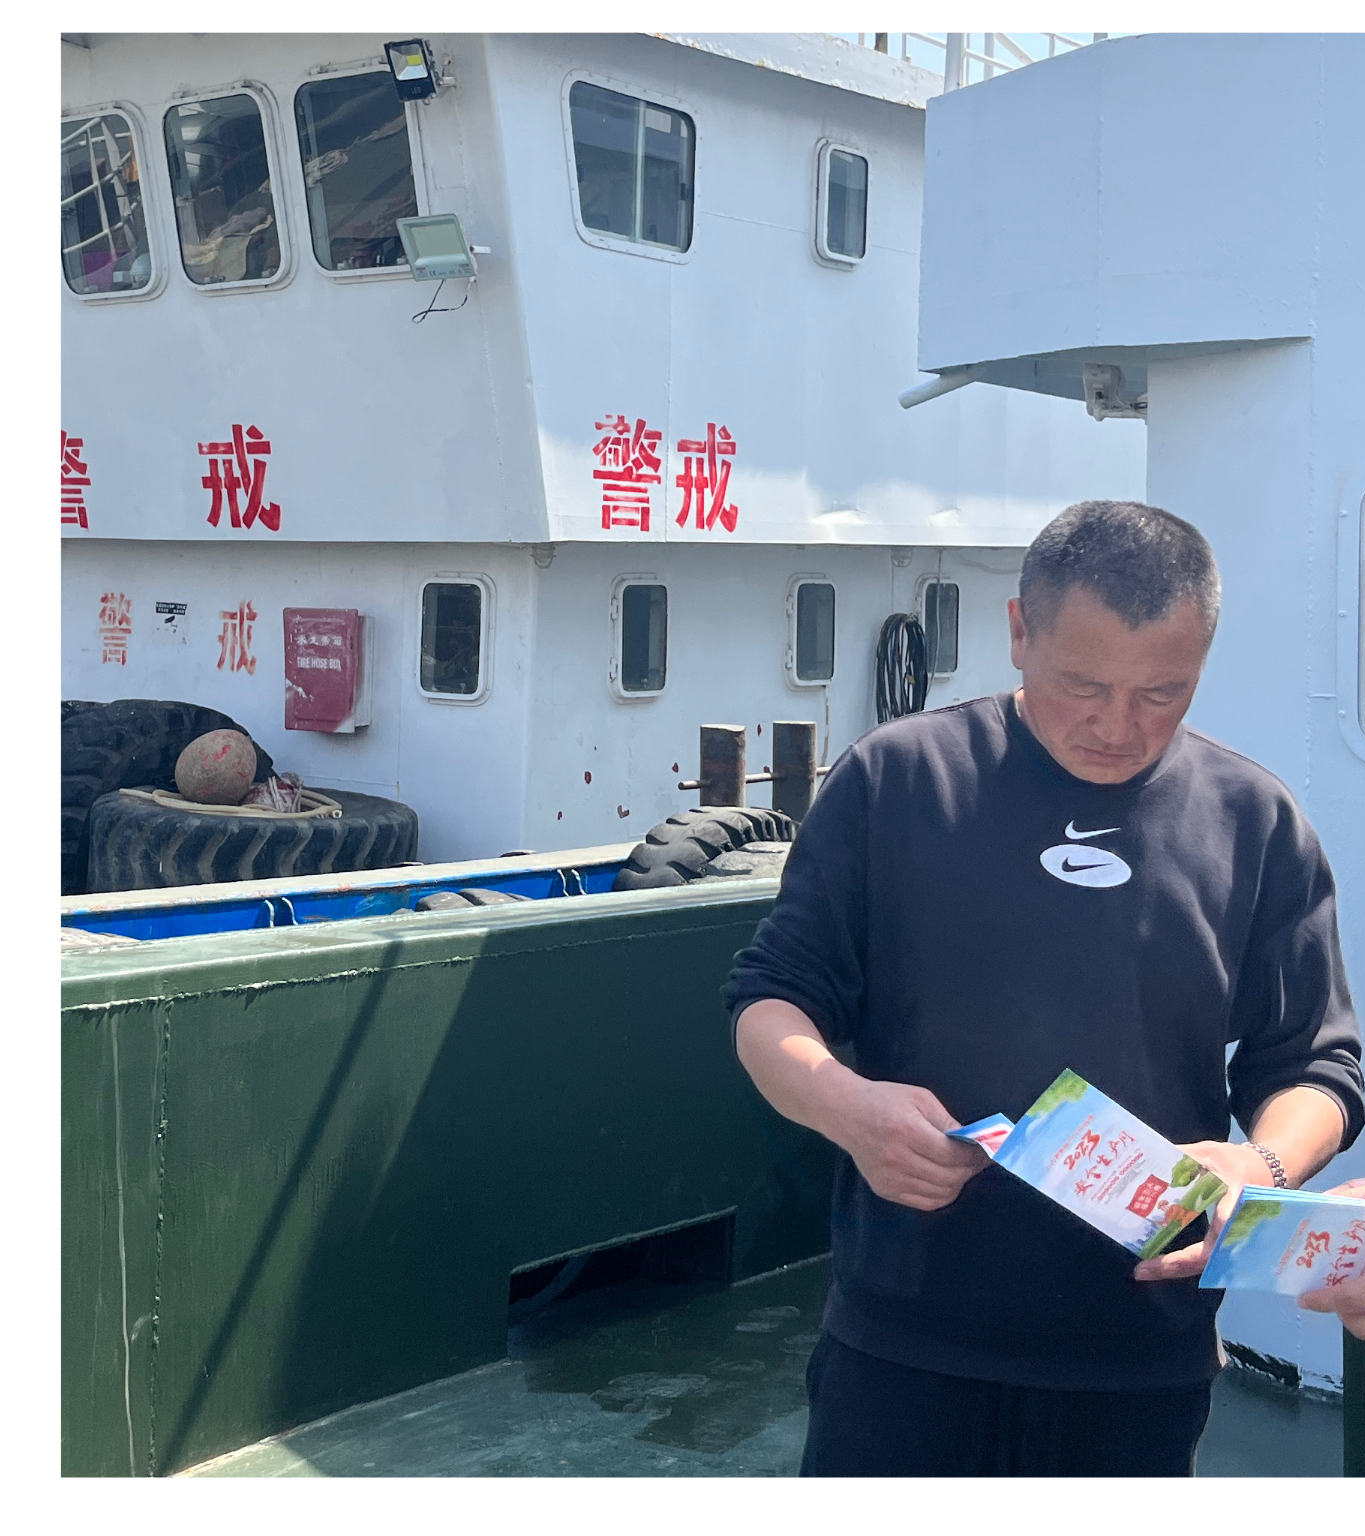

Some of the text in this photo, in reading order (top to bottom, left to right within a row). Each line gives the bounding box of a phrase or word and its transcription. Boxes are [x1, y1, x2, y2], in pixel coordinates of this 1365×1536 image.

[592, 414, 739, 532] 警戒
[100, 592, 257, 676] 警戒
[297, 656, 342, 672] FIRE HOSE BOX
[1063, 1129, 1099, 1170] 2023
[1295, 1230, 1329, 1268] 2023
